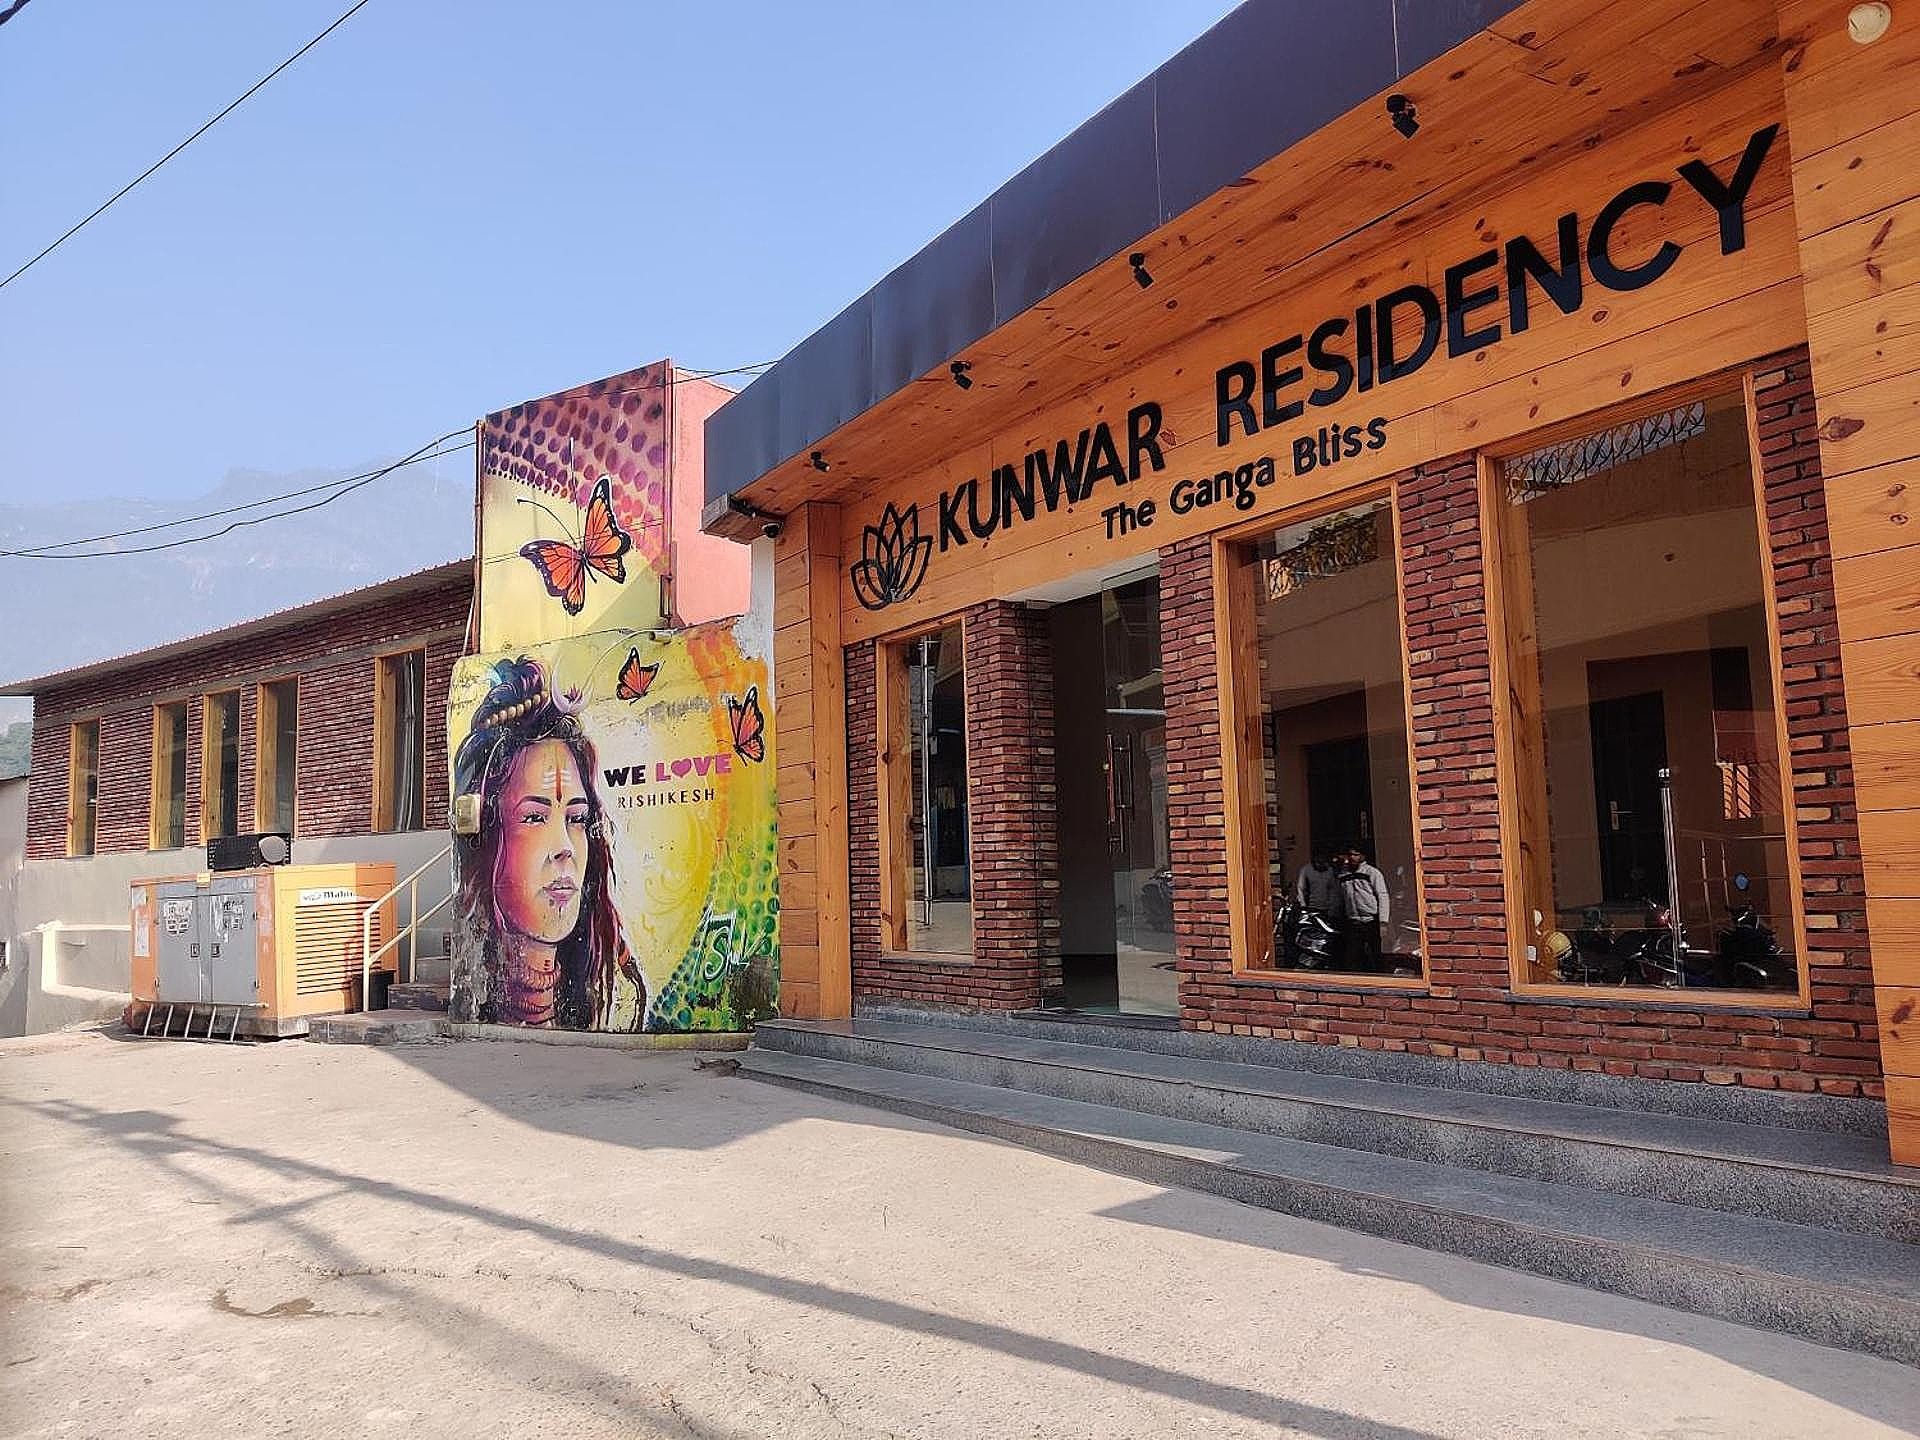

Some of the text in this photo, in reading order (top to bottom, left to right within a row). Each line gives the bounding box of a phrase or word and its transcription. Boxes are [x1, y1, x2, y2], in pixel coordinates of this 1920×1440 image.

[937, 122, 1781, 553] KUNWAR RESIDENCY
[1101, 416, 1388, 540] The Ganga Bliss
[603, 765, 646, 788] WE
[617, 788, 715, 808] RISHIKESH
